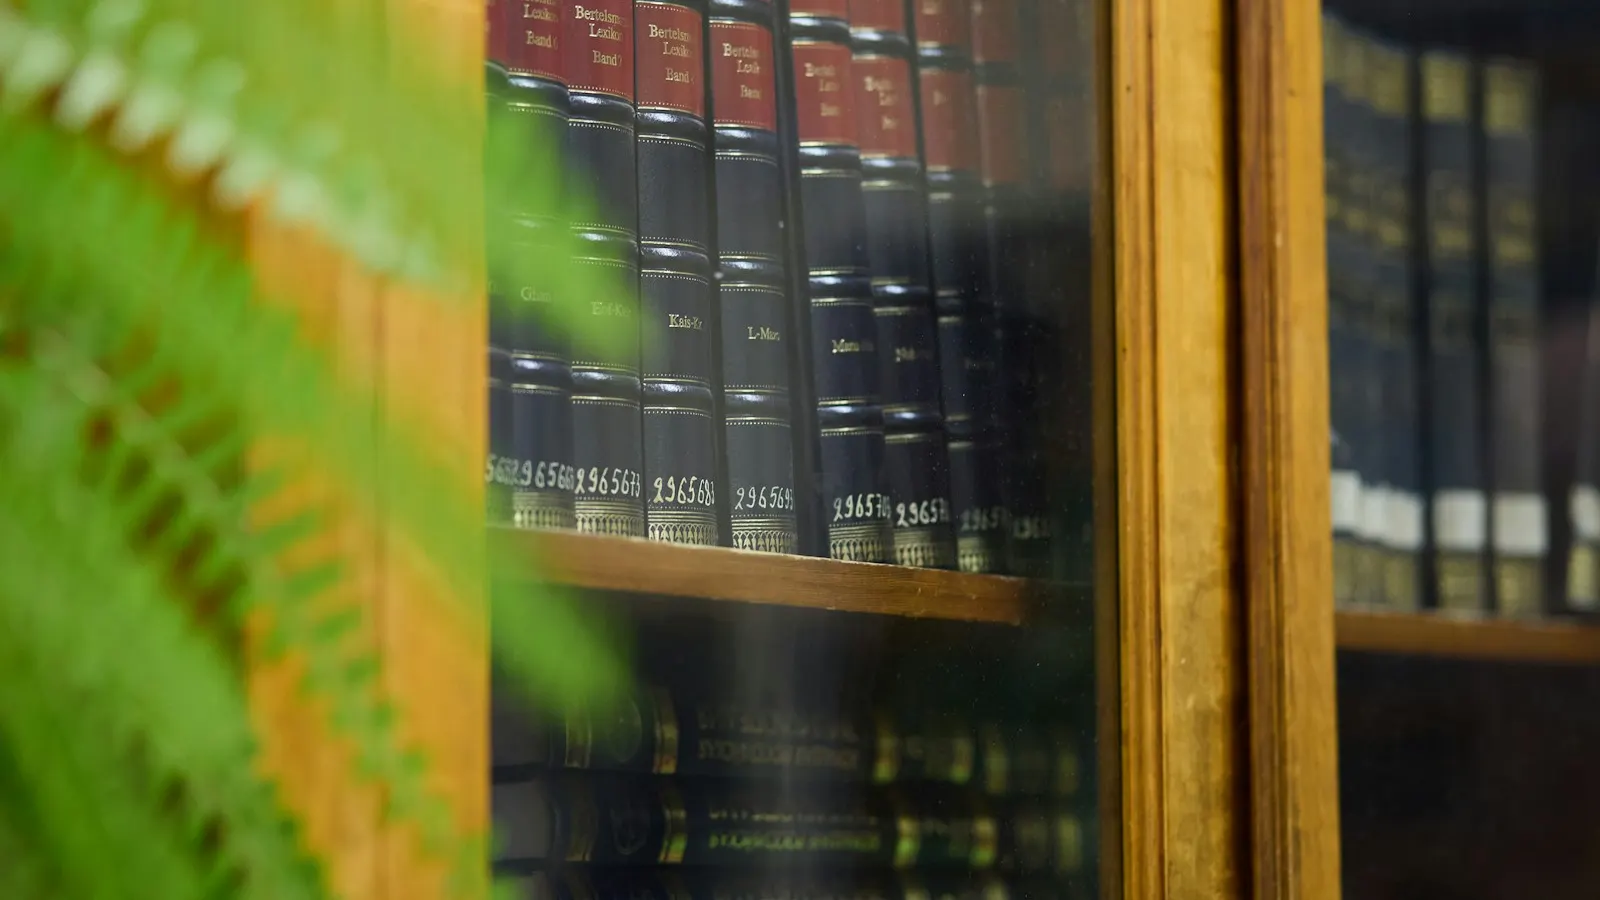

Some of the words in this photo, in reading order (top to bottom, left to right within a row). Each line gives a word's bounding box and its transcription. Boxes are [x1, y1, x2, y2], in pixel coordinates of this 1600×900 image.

[525, 30, 552, 48] Band
[593, 50, 617, 66] Band
[665, 67, 690, 83] Band
[574, 467, 641, 498] 2965673
